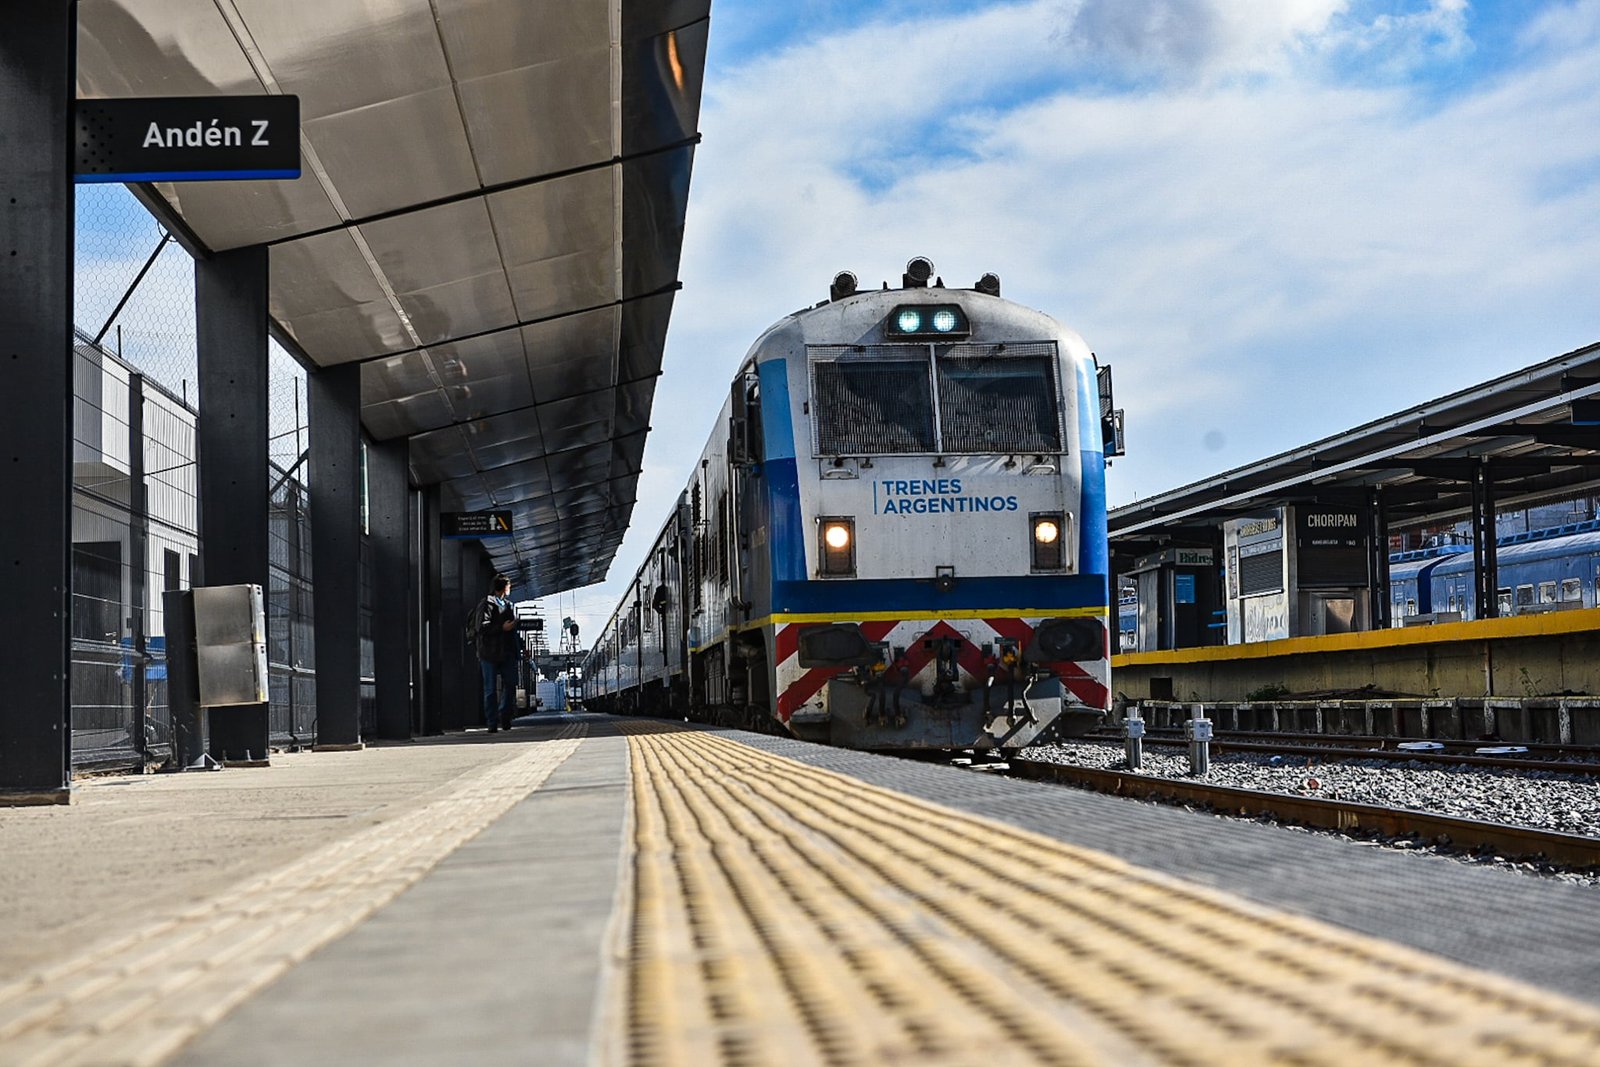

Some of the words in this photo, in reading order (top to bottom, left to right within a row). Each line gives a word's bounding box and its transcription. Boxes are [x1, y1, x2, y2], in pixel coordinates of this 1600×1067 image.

[142, 118, 242, 148] Andén
[251, 120, 269, 146] Z
[882, 479, 962, 496] TRENES
[883, 496, 1018, 514] ARGENTINOS
[1307, 514, 1357, 528] CHORIPAN
